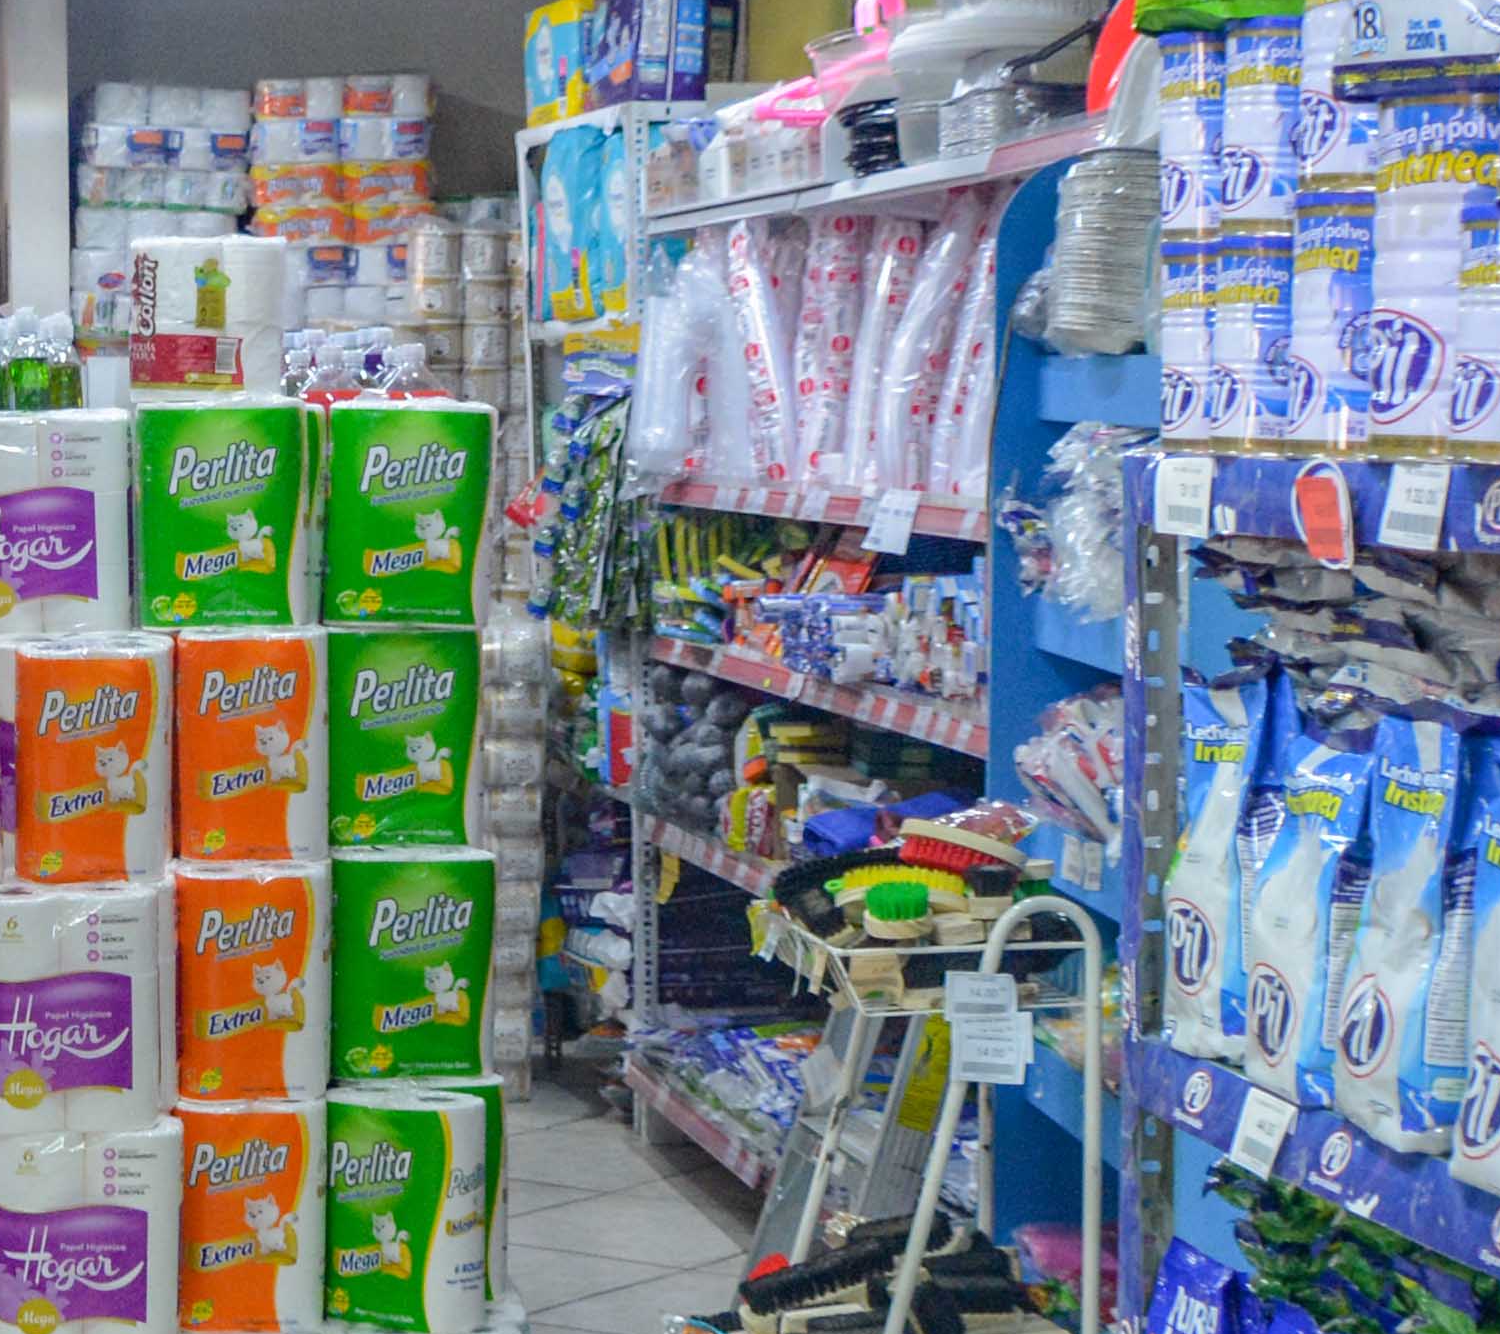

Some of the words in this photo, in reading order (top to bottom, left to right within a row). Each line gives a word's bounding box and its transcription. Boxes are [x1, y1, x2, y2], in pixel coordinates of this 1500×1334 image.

[1352, 5, 1379, 41] 18
[1405, 30, 1436, 51] 2200
[168, 440, 279, 496] Perlita
[360, 443, 468, 494] Perlita
[184, 550, 236, 580] Mega
[371, 548, 425, 575] Mega
[199, 663, 298, 716] Perlita
[350, 662, 456, 718] Perlita
[37, 683, 139, 736] Perlita
[211, 767, 265, 797] Extra
[363, 772, 415, 799] Mega
[49, 788, 104, 819] Extra
[196, 902, 296, 956] Perlita
[368, 893, 473, 948] Perlita
[208, 1006, 262, 1036] Extra
[382, 1003, 433, 1033] Mega
[187, 1139, 289, 1189] Perlita
[329, 1140, 413, 1189] Perlita
[3, 1225, 144, 1292] Hogar
[200, 1240, 254, 1268] Extra
[339, 1250, 380, 1274] Mega
